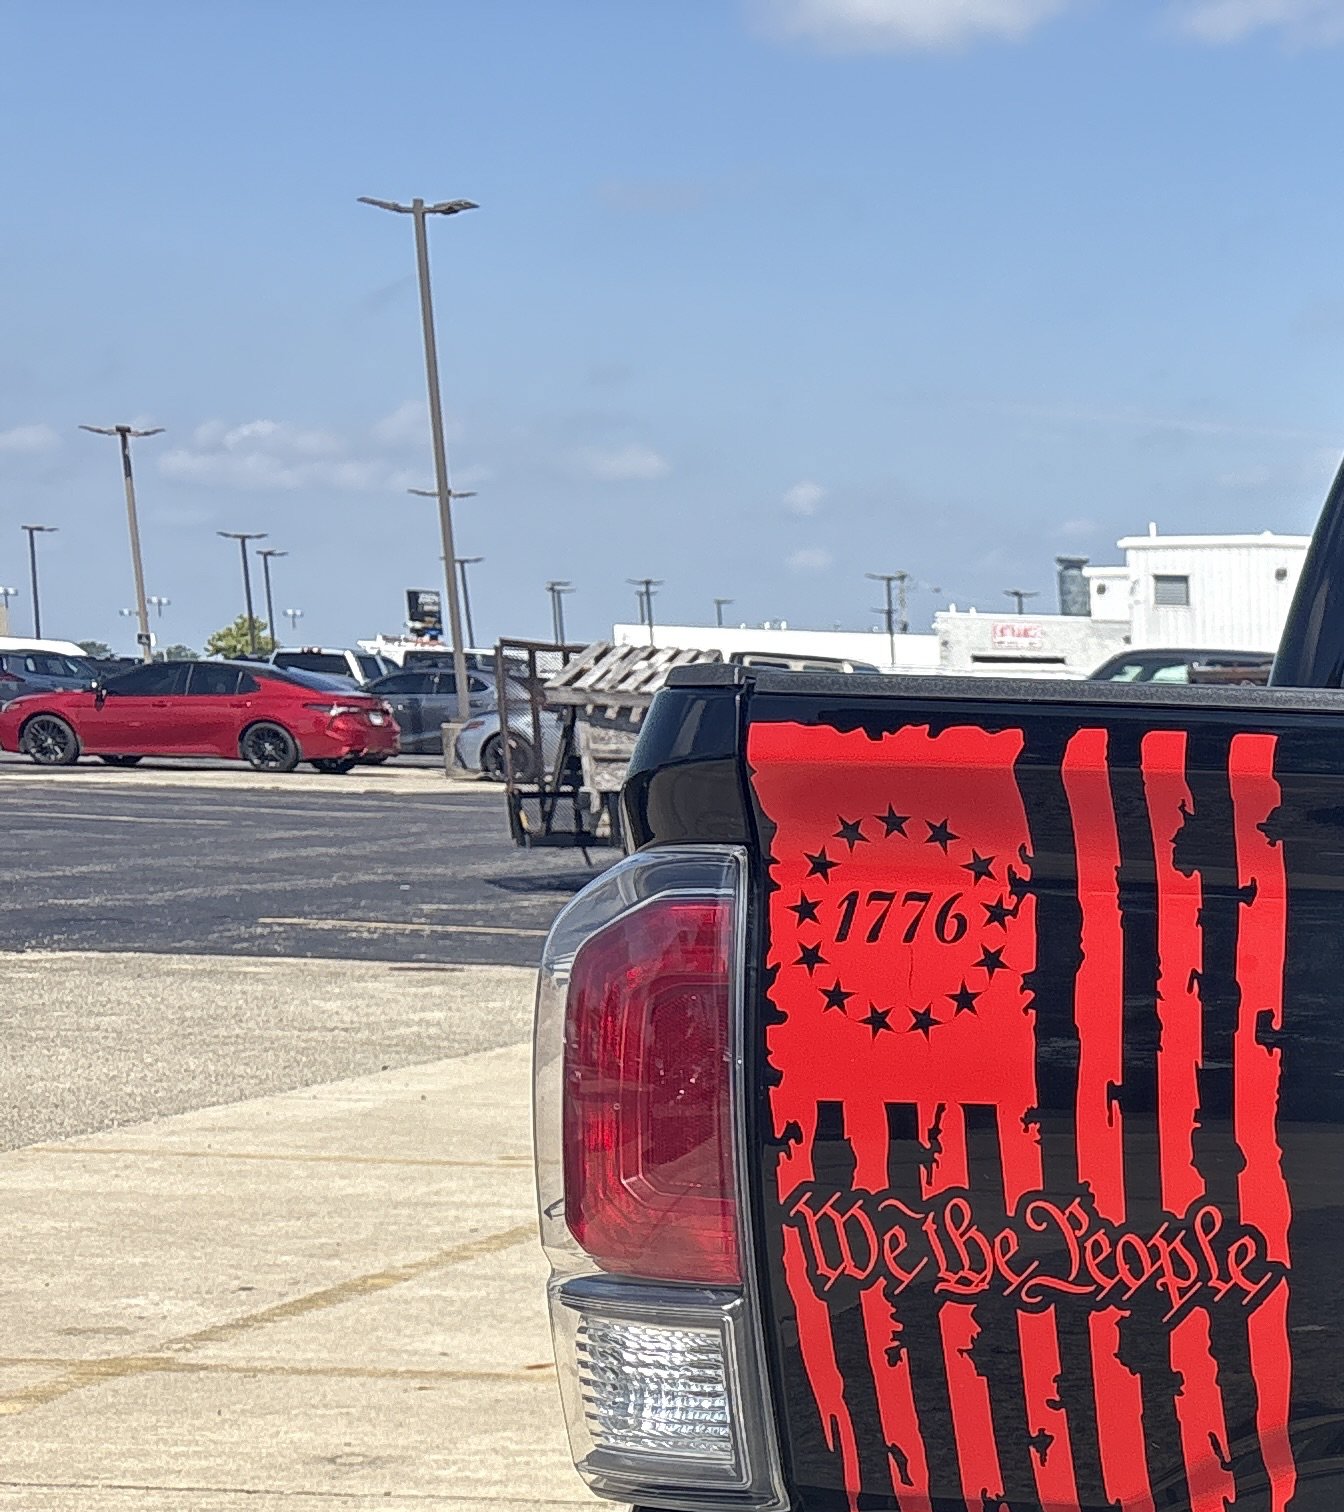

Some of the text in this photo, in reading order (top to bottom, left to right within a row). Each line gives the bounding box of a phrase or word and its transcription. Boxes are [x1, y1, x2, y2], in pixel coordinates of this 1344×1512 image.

[834, 889, 969, 945] 1776
[790, 1192, 1273, 1323] We the People
